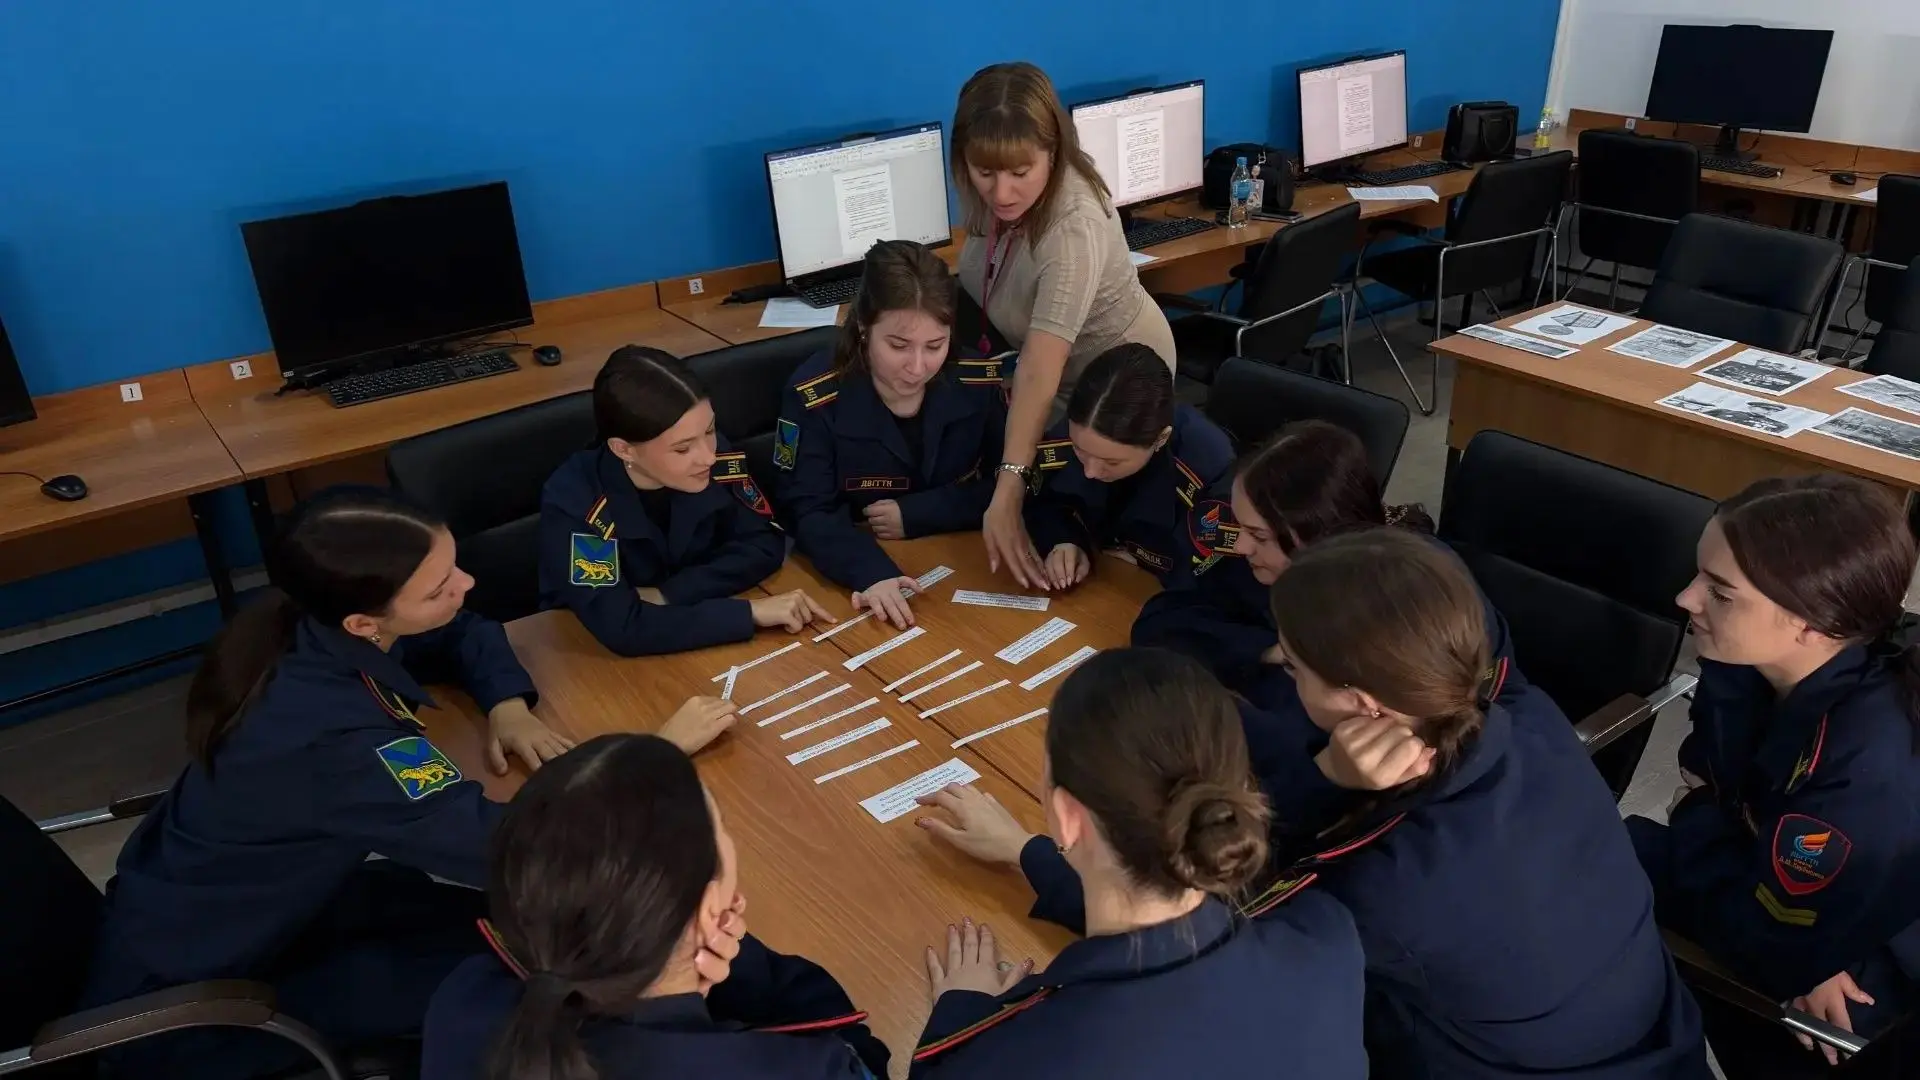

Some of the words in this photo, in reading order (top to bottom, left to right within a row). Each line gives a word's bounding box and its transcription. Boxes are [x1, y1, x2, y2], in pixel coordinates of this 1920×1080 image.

[693, 281, 700, 292] 3
[236, 365, 246, 376] 2
[129, 387, 135, 398] 1
